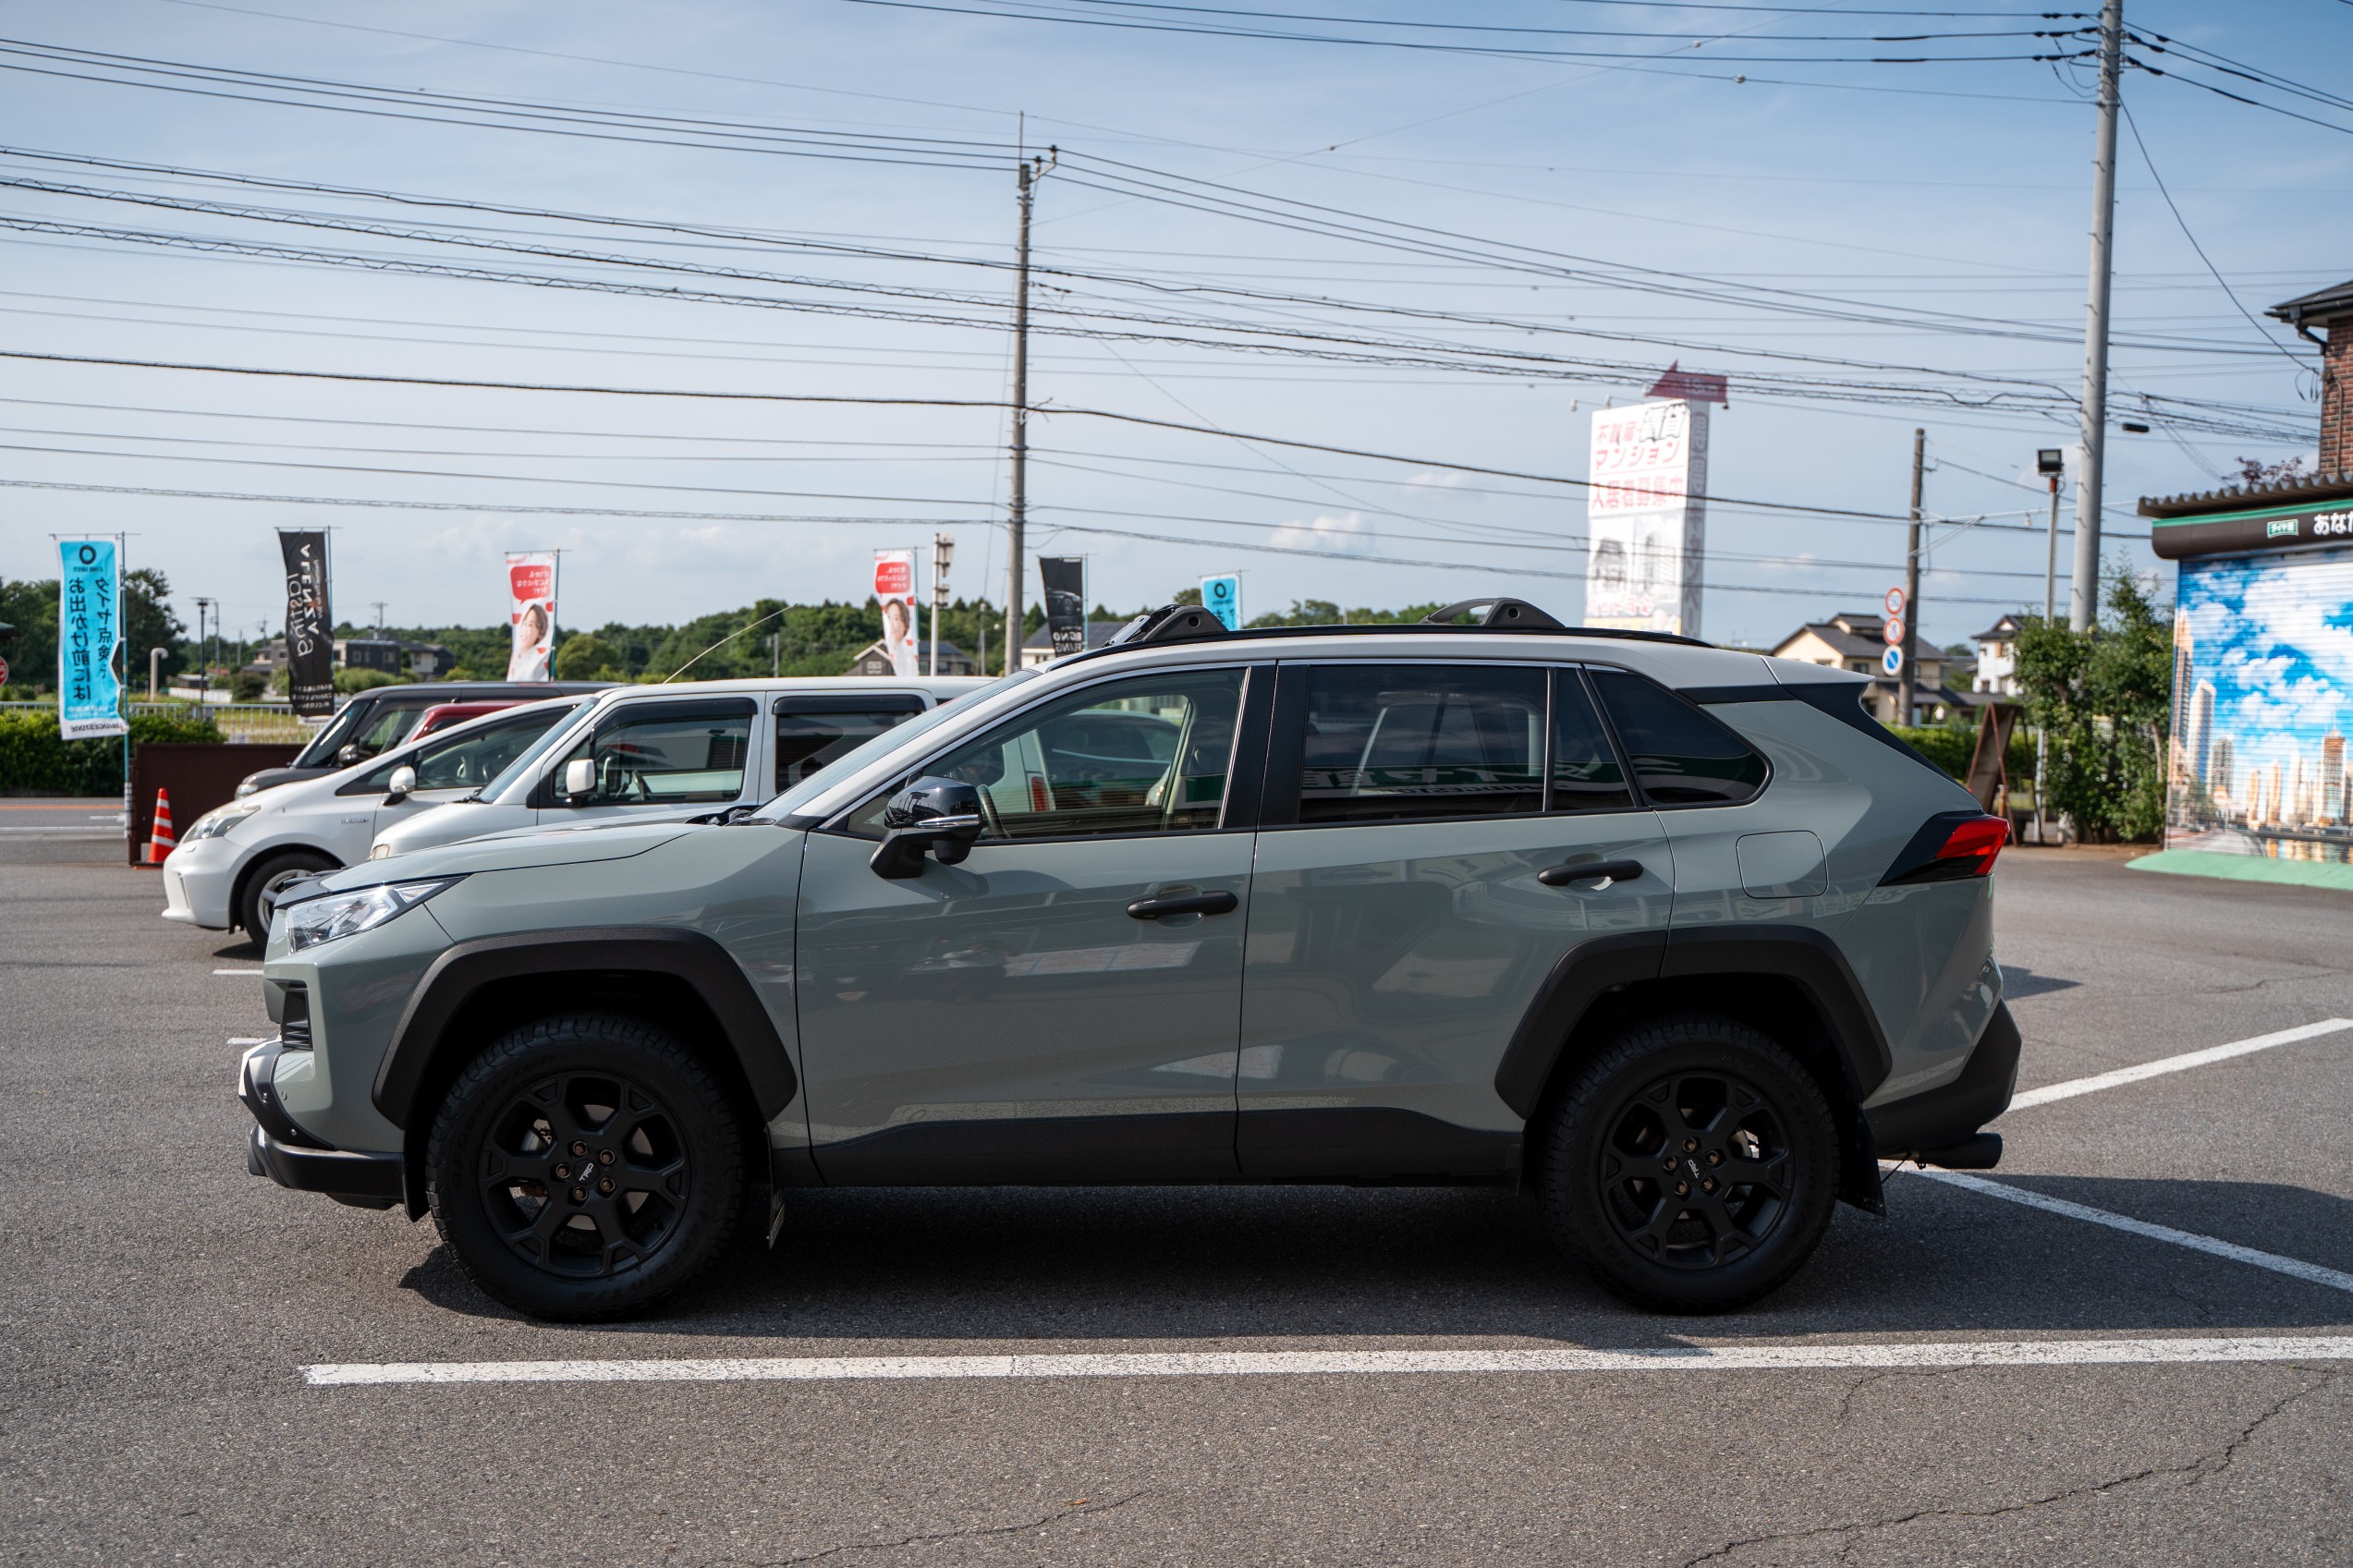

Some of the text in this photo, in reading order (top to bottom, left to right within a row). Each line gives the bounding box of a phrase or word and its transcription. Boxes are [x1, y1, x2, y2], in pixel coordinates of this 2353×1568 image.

[1596, 441, 1680, 470] マンション
[579, 1162, 594, 1183] TRD
[1688, 1159, 1701, 1179] TRD
